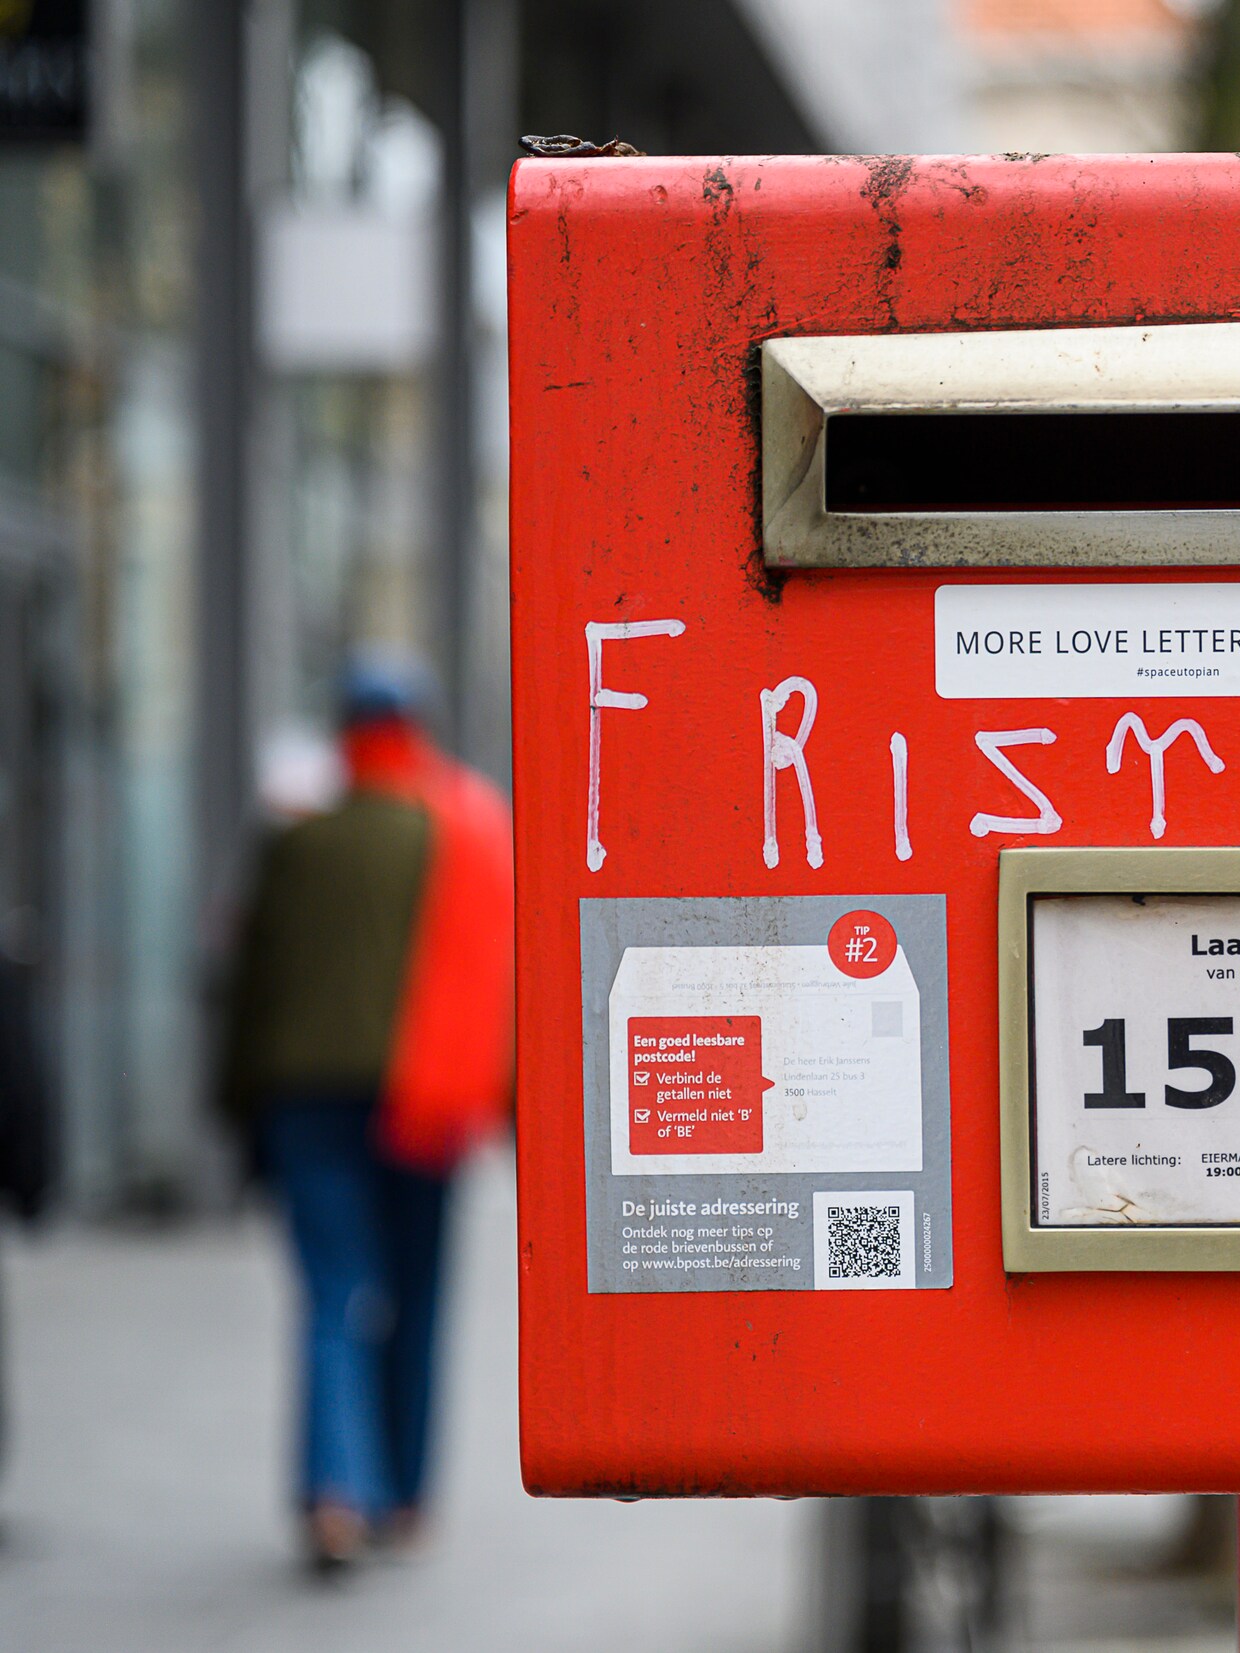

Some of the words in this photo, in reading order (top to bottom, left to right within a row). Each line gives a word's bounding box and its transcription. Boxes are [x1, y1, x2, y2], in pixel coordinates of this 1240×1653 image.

[956, 631, 1042, 655] MORE
[1055, 630, 1129, 654] LOVE
[1136, 666, 1220, 679] #spaceutopian
[854, 926, 870, 935] TIP
[845, 937, 878, 963] #2
[1206, 966, 1236, 980] van
[634, 1035, 656, 1047] Een
[659, 1034, 690, 1050] goed
[693, 1034, 745, 1046] leesbare
[634, 1049, 695, 1066] postcode!
[783, 1057, 795, 1066] De
[798, 1057, 816, 1066] heer
[819, 1056, 834, 1065] Erik
[836, 1057, 871, 1066] Janssens
[656, 1071, 703, 1084] Verbind
[706, 1071, 722, 1084] de
[830, 1072, 840, 1081] 25
[843, 1072, 858, 1081] bus
[859, 1072, 865, 1080] 3
[656, 1087, 704, 1104] getallen
[708, 1087, 732, 1099] niet
[784, 1088, 805, 1097] 3500
[807, 1087, 837, 1097] Hasselt
[657, 1109, 707, 1122] Vermeld
[711, 1109, 734, 1121] niet
[657, 1125, 671, 1137] of
[1087, 1154, 1129, 1167] Latere
[1131, 1154, 1182, 1169] lichting:
[1041, 1172, 1050, 1220] 23/07/2015
[622, 1200, 646, 1217] De
[648, 1199, 697, 1221] juiste
[700, 1198, 800, 1219] adressering
[622, 1226, 668, 1239] Ontdek
[671, 1228, 695, 1241] nog
[698, 1227, 729, 1238] meer
[731, 1225, 754, 1240] tips
[757, 1227, 773, 1240] op
[622, 1241, 638, 1254] de
[641, 1241, 669, 1254] rode
[672, 1240, 757, 1253] brievenbussen
[759, 1240, 774, 1252] of
[622, 1260, 639, 1273] op
[642, 1255, 801, 1272] www.bpost.be/adressering
